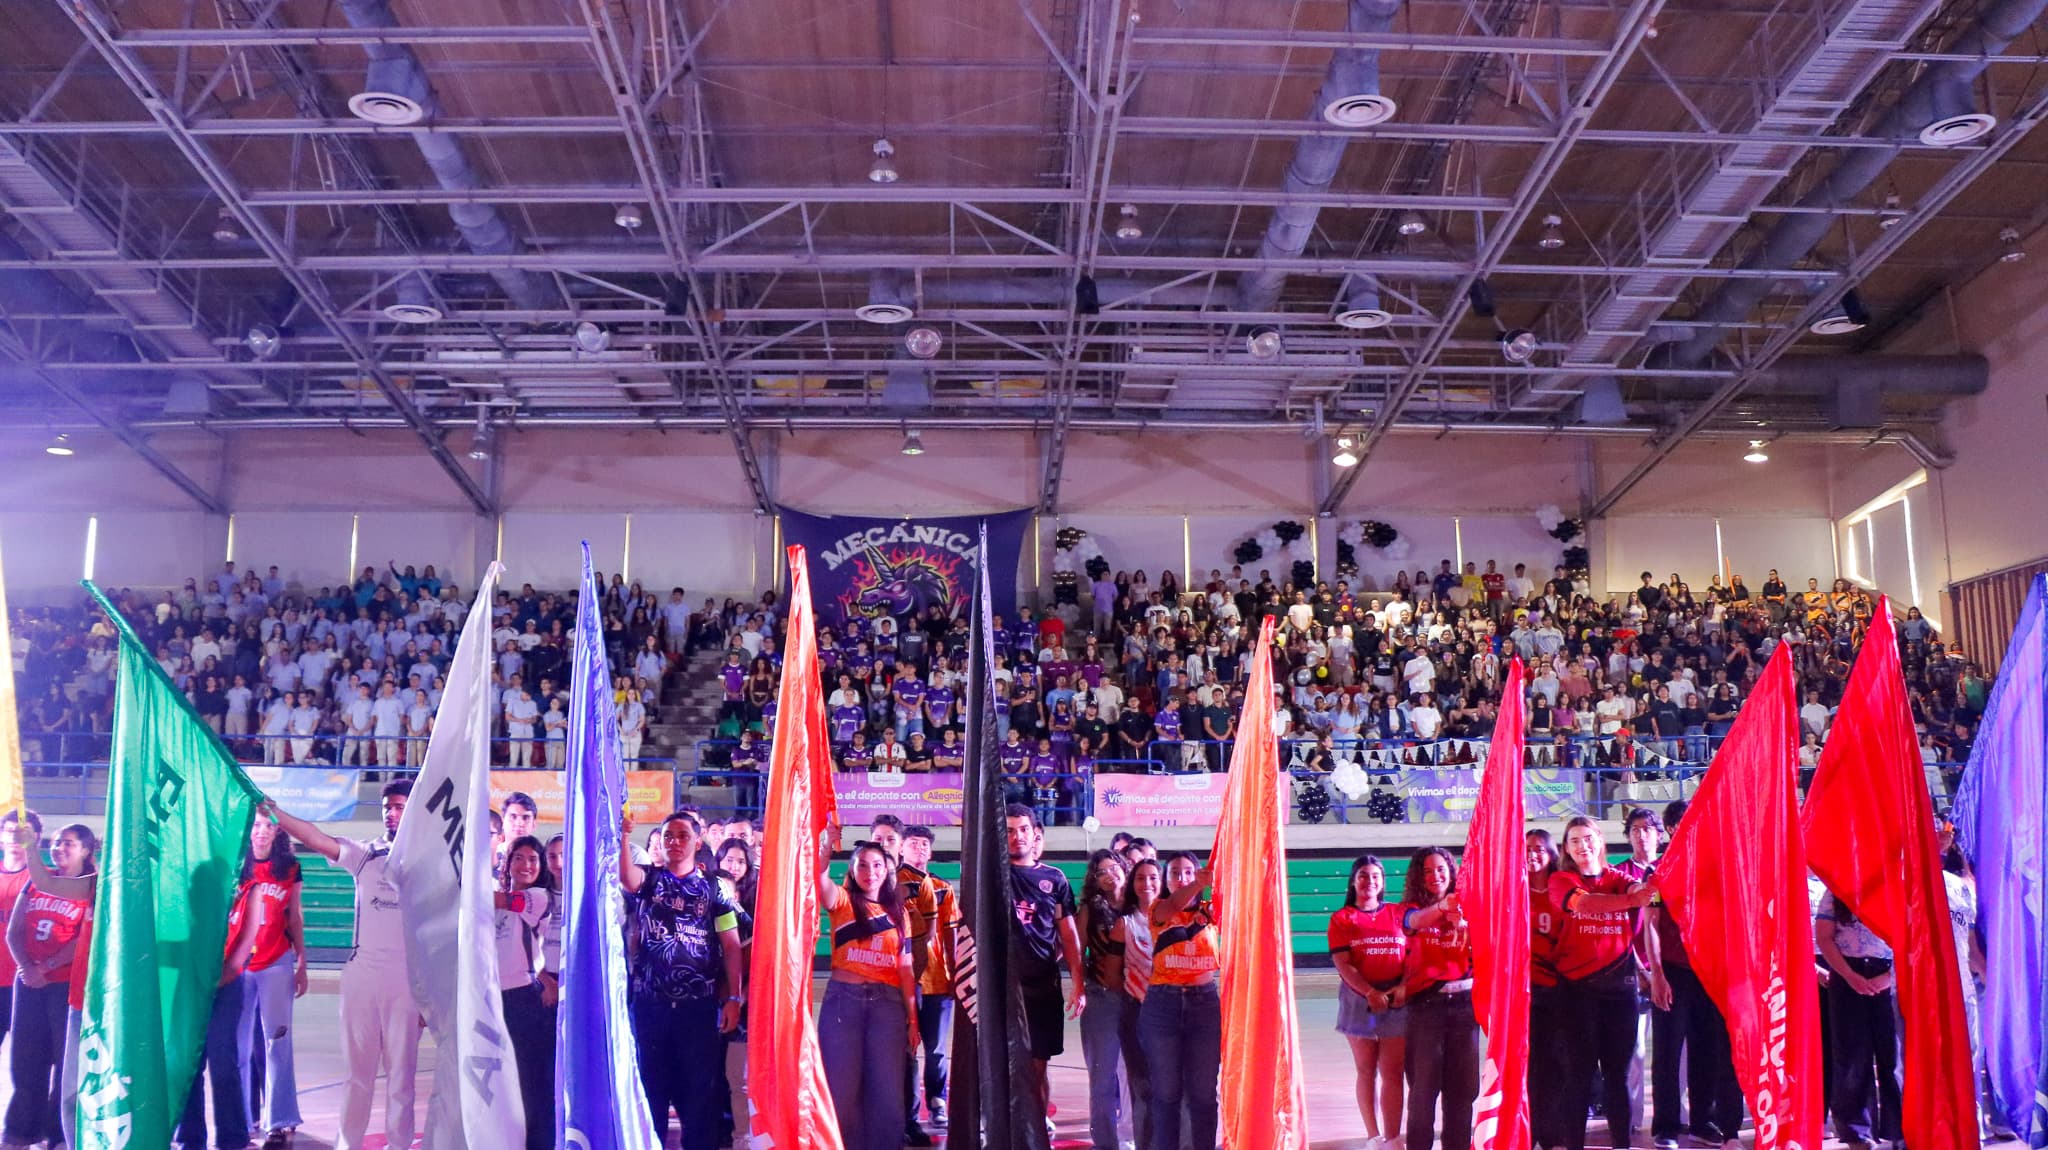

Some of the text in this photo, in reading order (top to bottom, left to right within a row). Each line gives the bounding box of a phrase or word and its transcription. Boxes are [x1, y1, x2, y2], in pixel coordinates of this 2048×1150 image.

[858, 790, 899, 801] deporte
[901, 792, 920, 800] con
[1408, 786, 1444, 797] Vivimos
[1203, 794, 1221, 803] con
[1538, 912, 1551, 934] 9
[35, 919, 54, 941] 9
